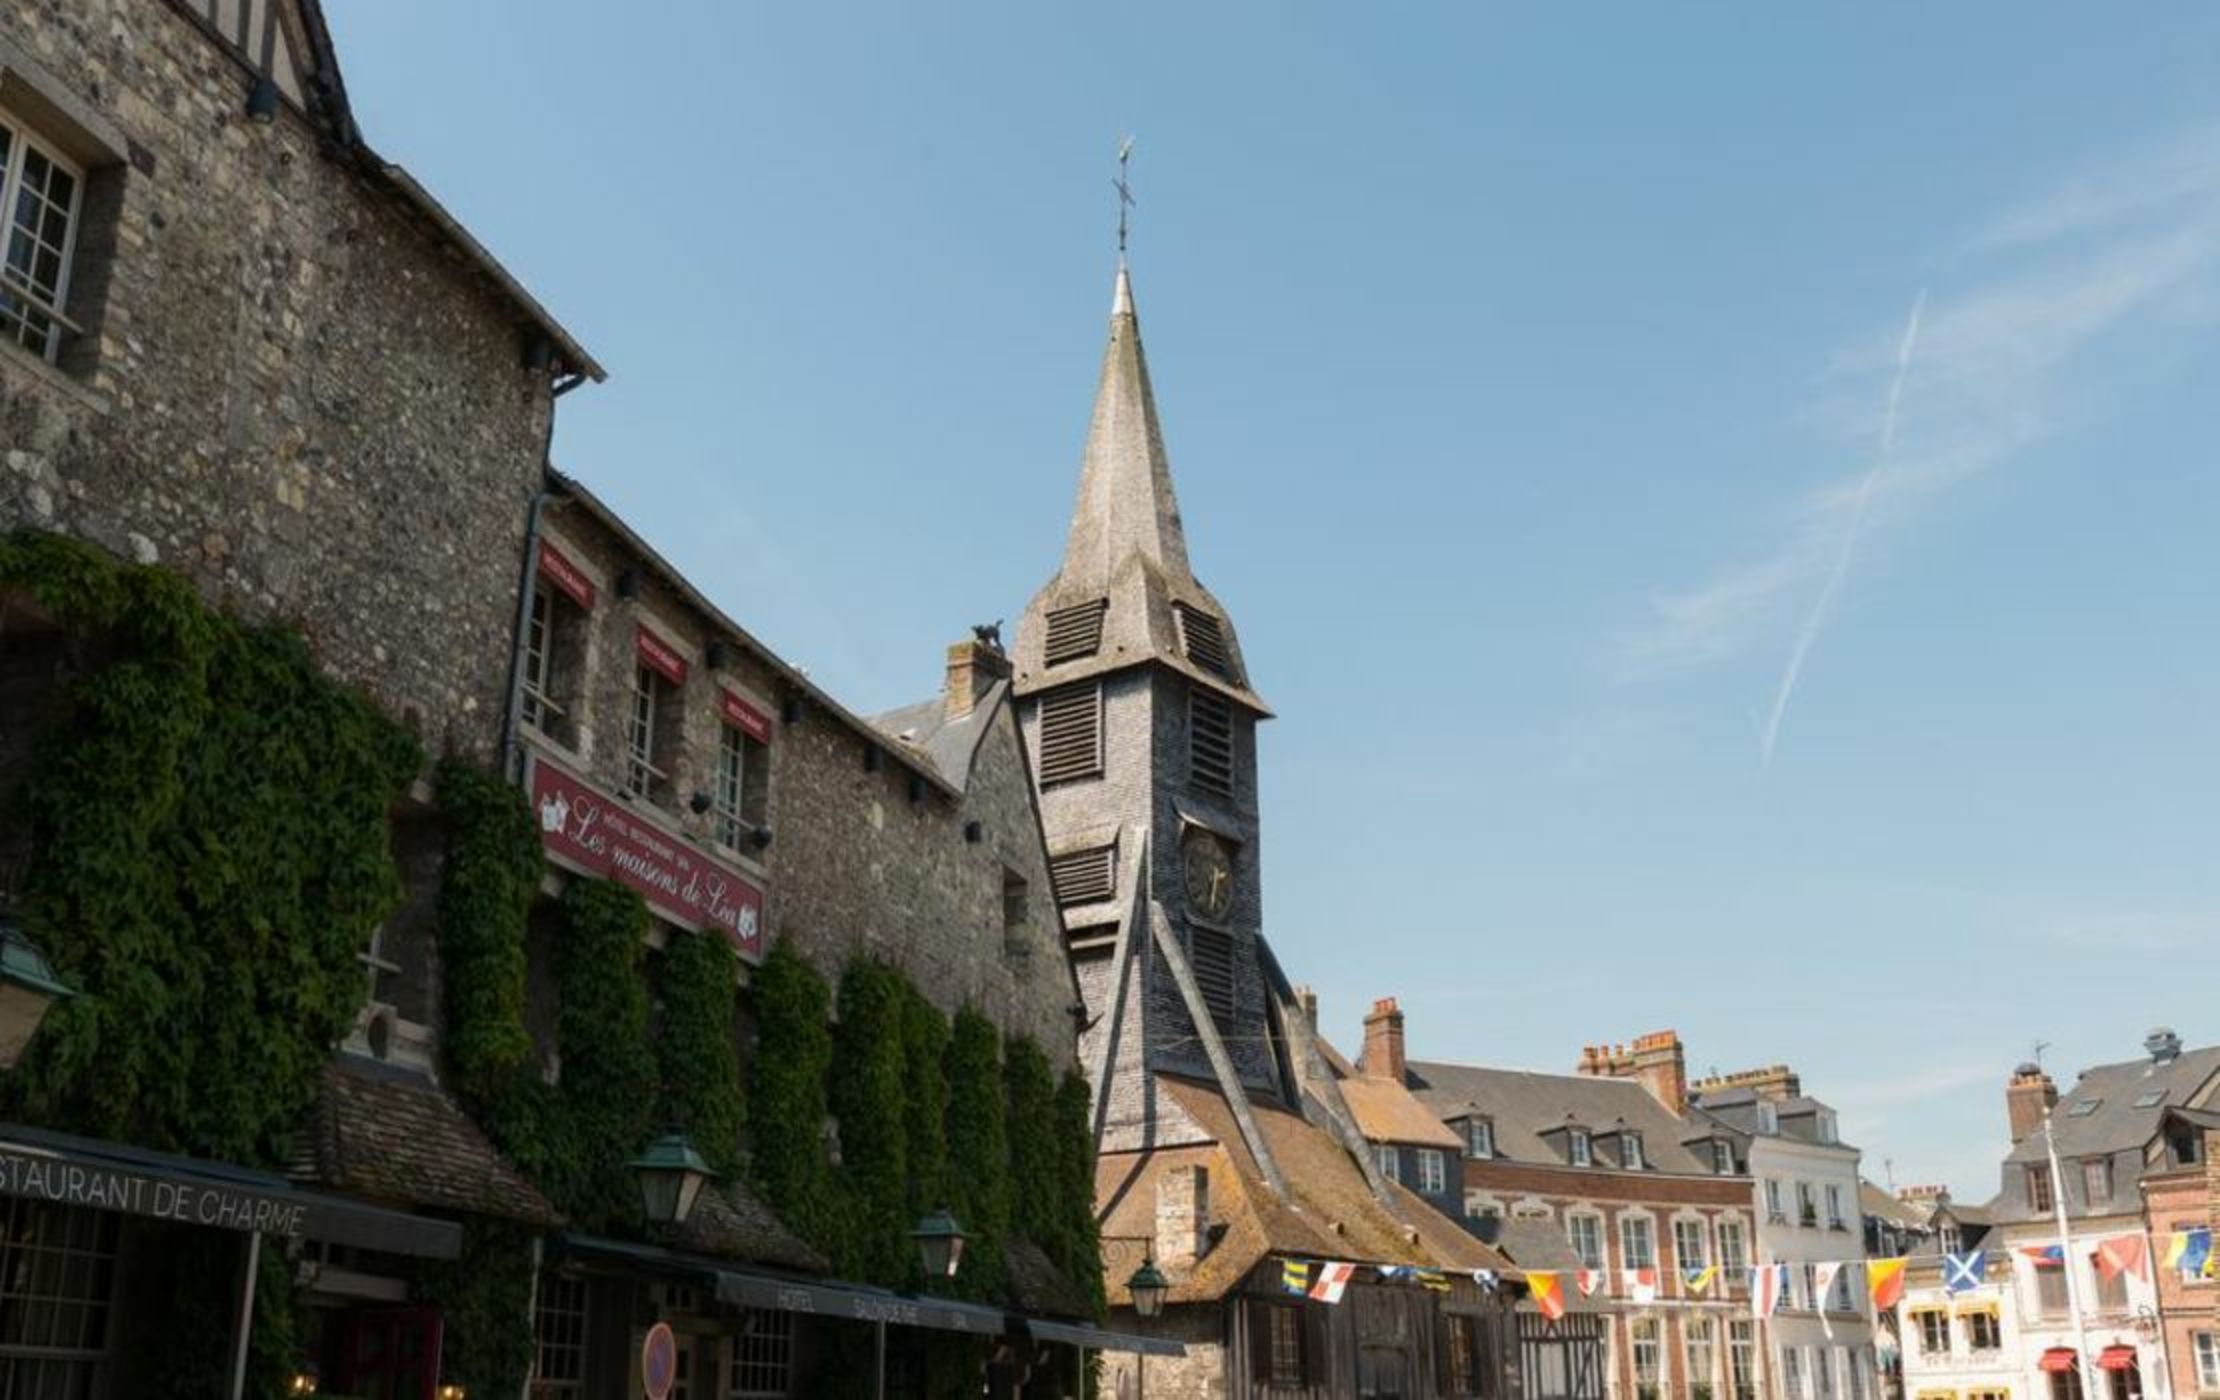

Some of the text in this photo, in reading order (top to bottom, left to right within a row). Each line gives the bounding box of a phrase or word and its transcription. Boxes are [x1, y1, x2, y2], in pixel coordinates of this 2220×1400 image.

[568, 796, 606, 856] Les
[613, 844, 678, 897] maisons
[681, 871, 701, 907] de
[152, 1182, 191, 1221] DE
[199, 1190, 306, 1235] CHARME
